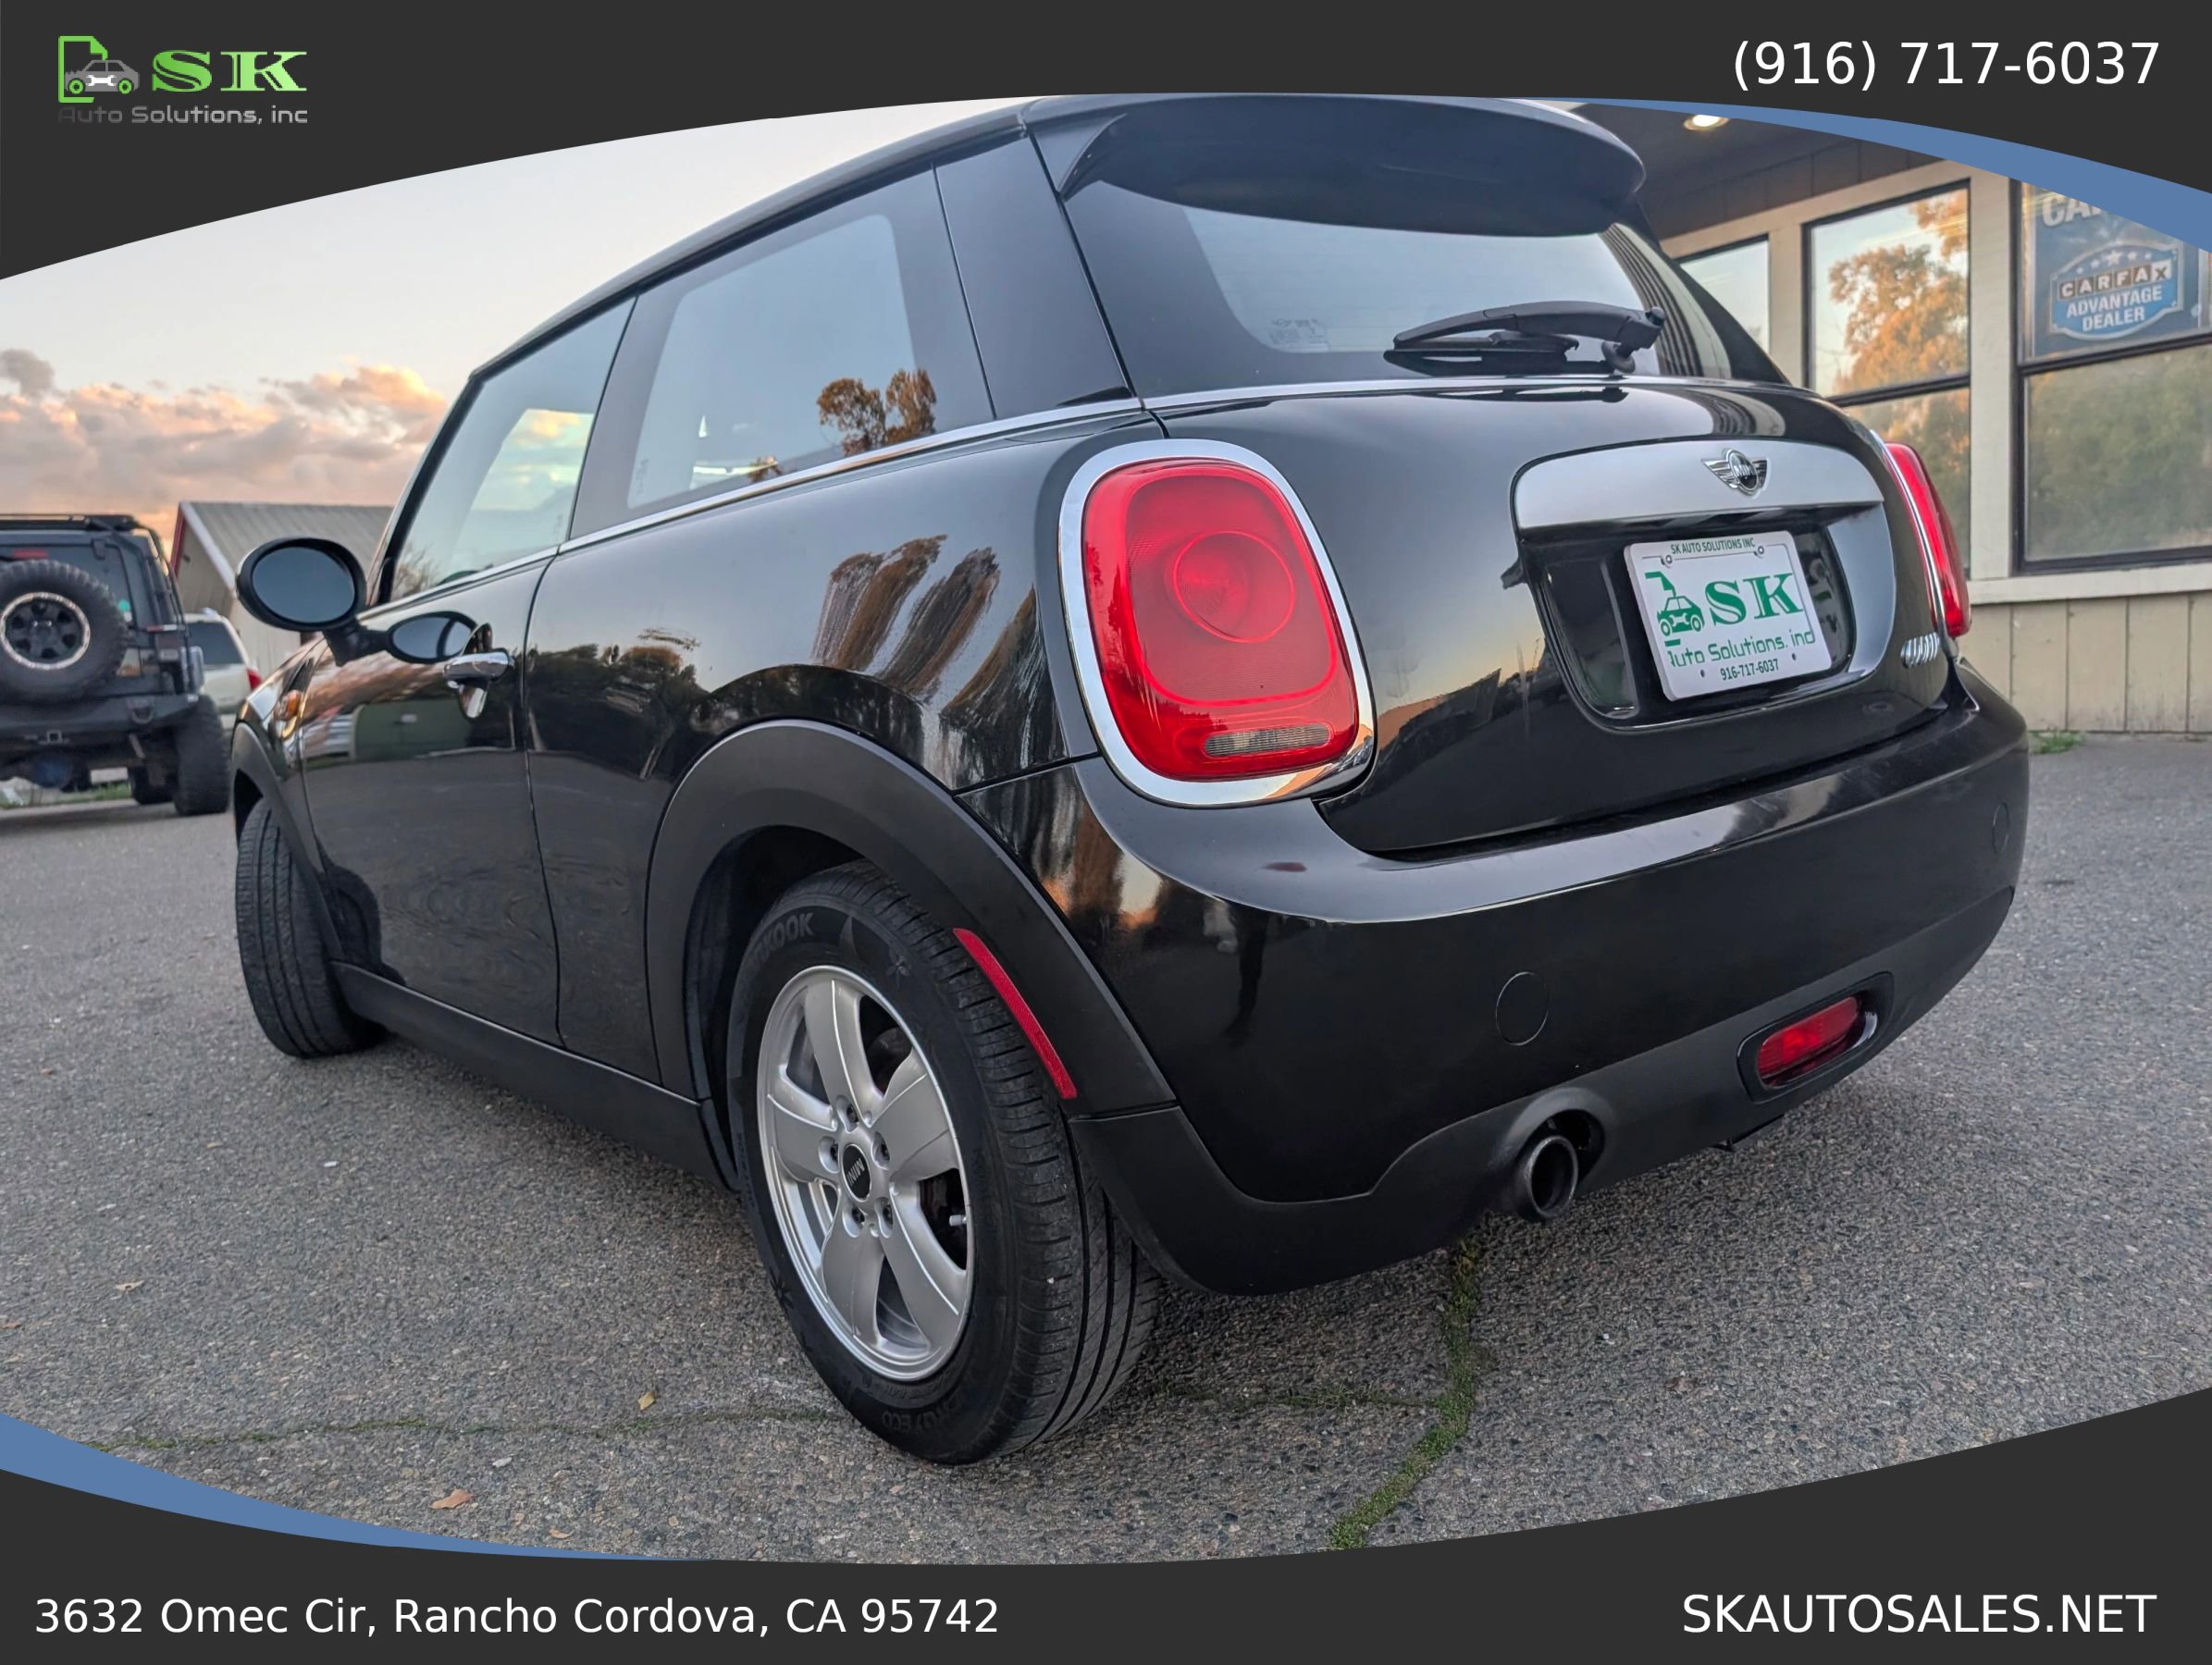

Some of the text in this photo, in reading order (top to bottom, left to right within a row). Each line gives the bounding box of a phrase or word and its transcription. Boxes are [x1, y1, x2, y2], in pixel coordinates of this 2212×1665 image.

[2060, 265, 2169, 298] CARFAX
[2066, 285, 2163, 318] ADVANTAGE
[2082, 305, 2145, 332] DEALER
[1670, 537, 1756, 555] SK AUTO SOLUTIONS INC
[1704, 573, 1804, 626] SK
[1720, 658, 1779, 681] 916-717-6037
